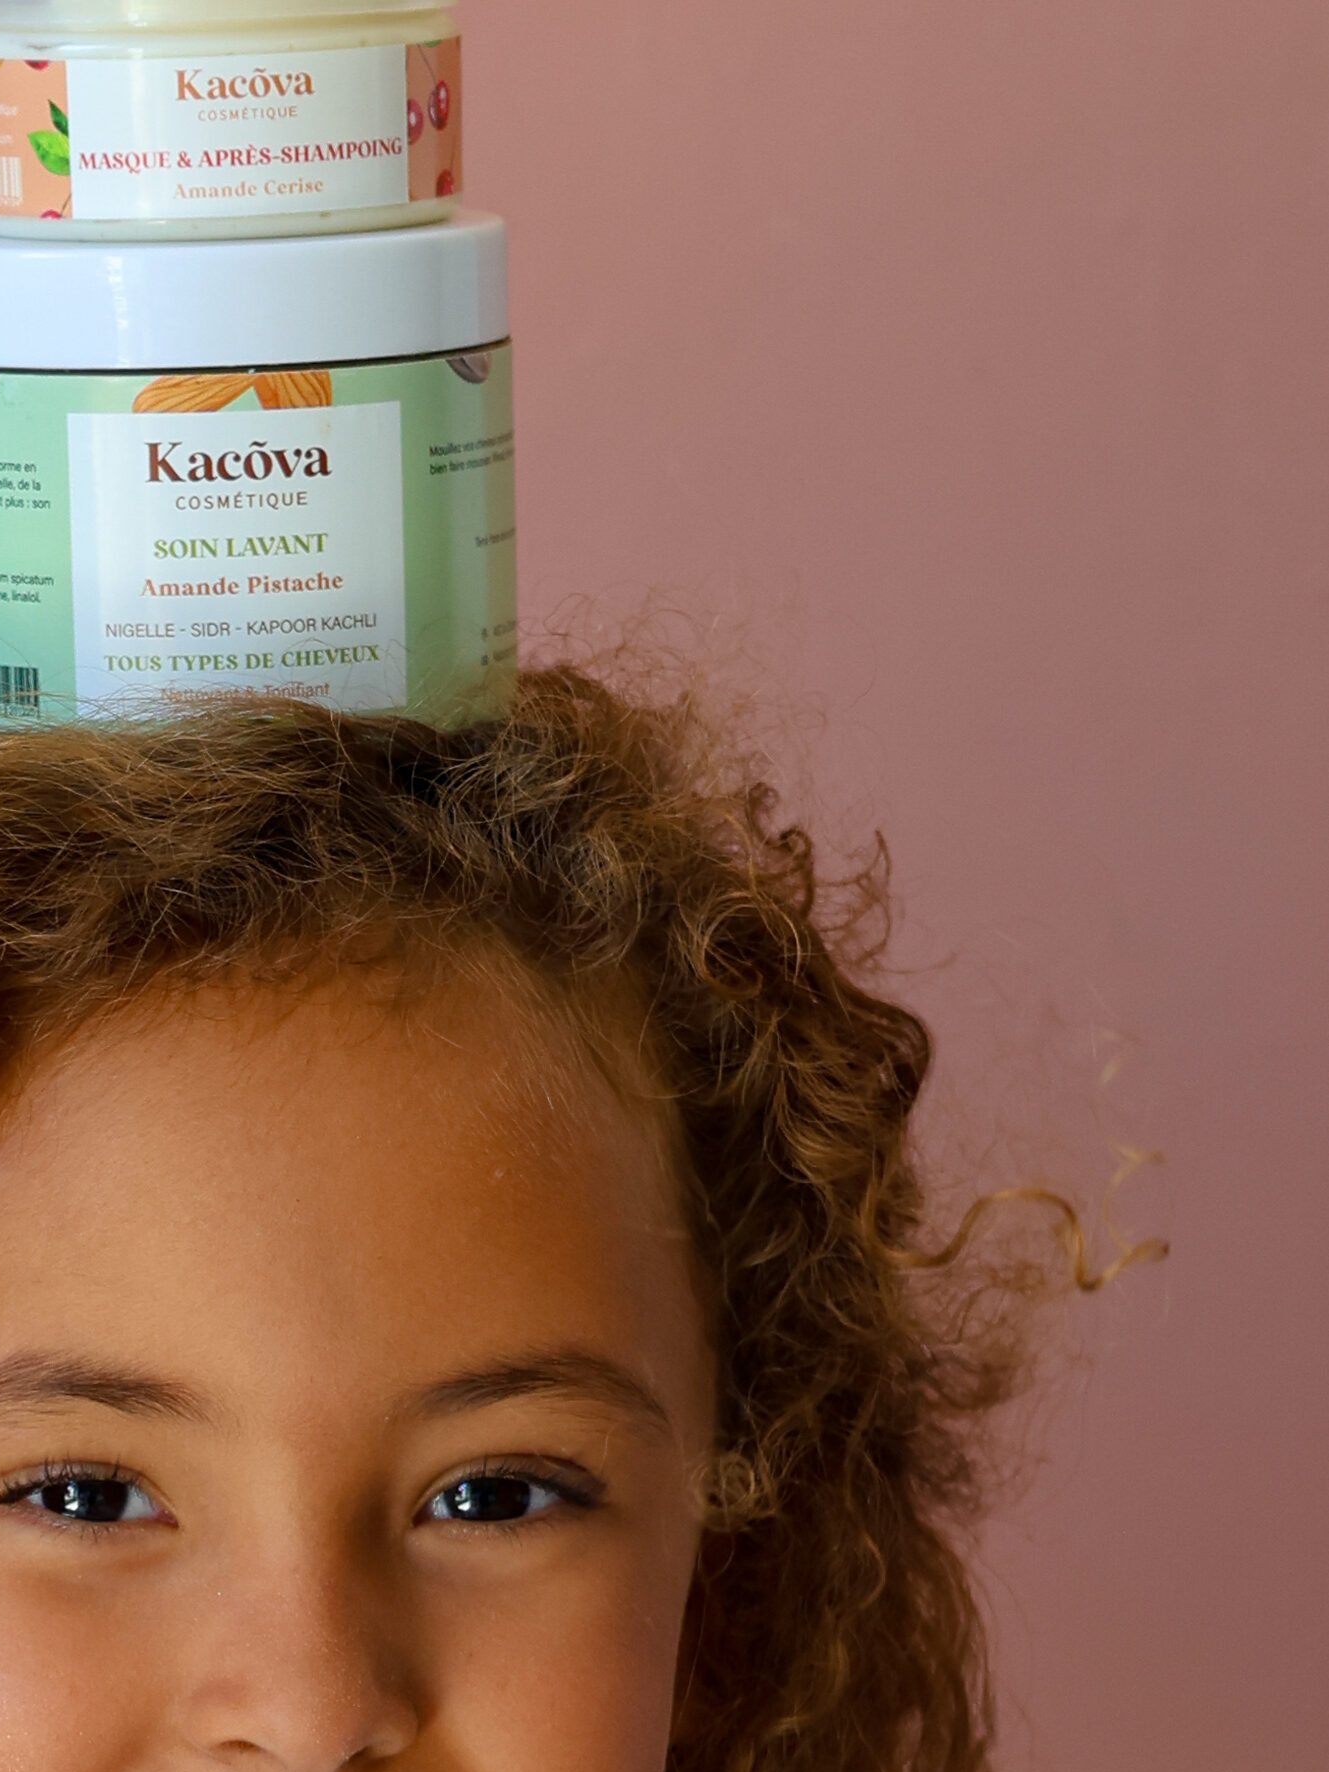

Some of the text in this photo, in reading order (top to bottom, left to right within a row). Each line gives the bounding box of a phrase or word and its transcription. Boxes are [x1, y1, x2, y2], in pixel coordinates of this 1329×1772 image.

[174, 67, 315, 100] Kacõva
[198, 106, 298, 121] COSMÉTIQUE
[78, 137, 402, 174] MASQUE & APRÈS-SHAMPOING
[173, 177, 324, 199] Amande Cerise
[24, 463, 37, 473] en
[144, 441, 333, 483] Kacõva
[17, 479, 30, 490] de
[32, 480, 41, 491] la
[4, 497, 25, 509] plus
[32, 499, 51, 510] son
[175, 491, 309, 510] COSMÉTIQUE
[153, 533, 329, 559] SOIN LAVANT
[10, 573, 54, 587] spicatum
[140, 571, 344, 597] Amande Pistache
[105, 623, 176, 638] NIGELLE
[190, 621, 231, 638] SIDR
[246, 618, 317, 636] KAPOOR
[320, 613, 377, 631] KACHLI
[104, 644, 380, 672] TOUS TYPES DE CHEVEUX
